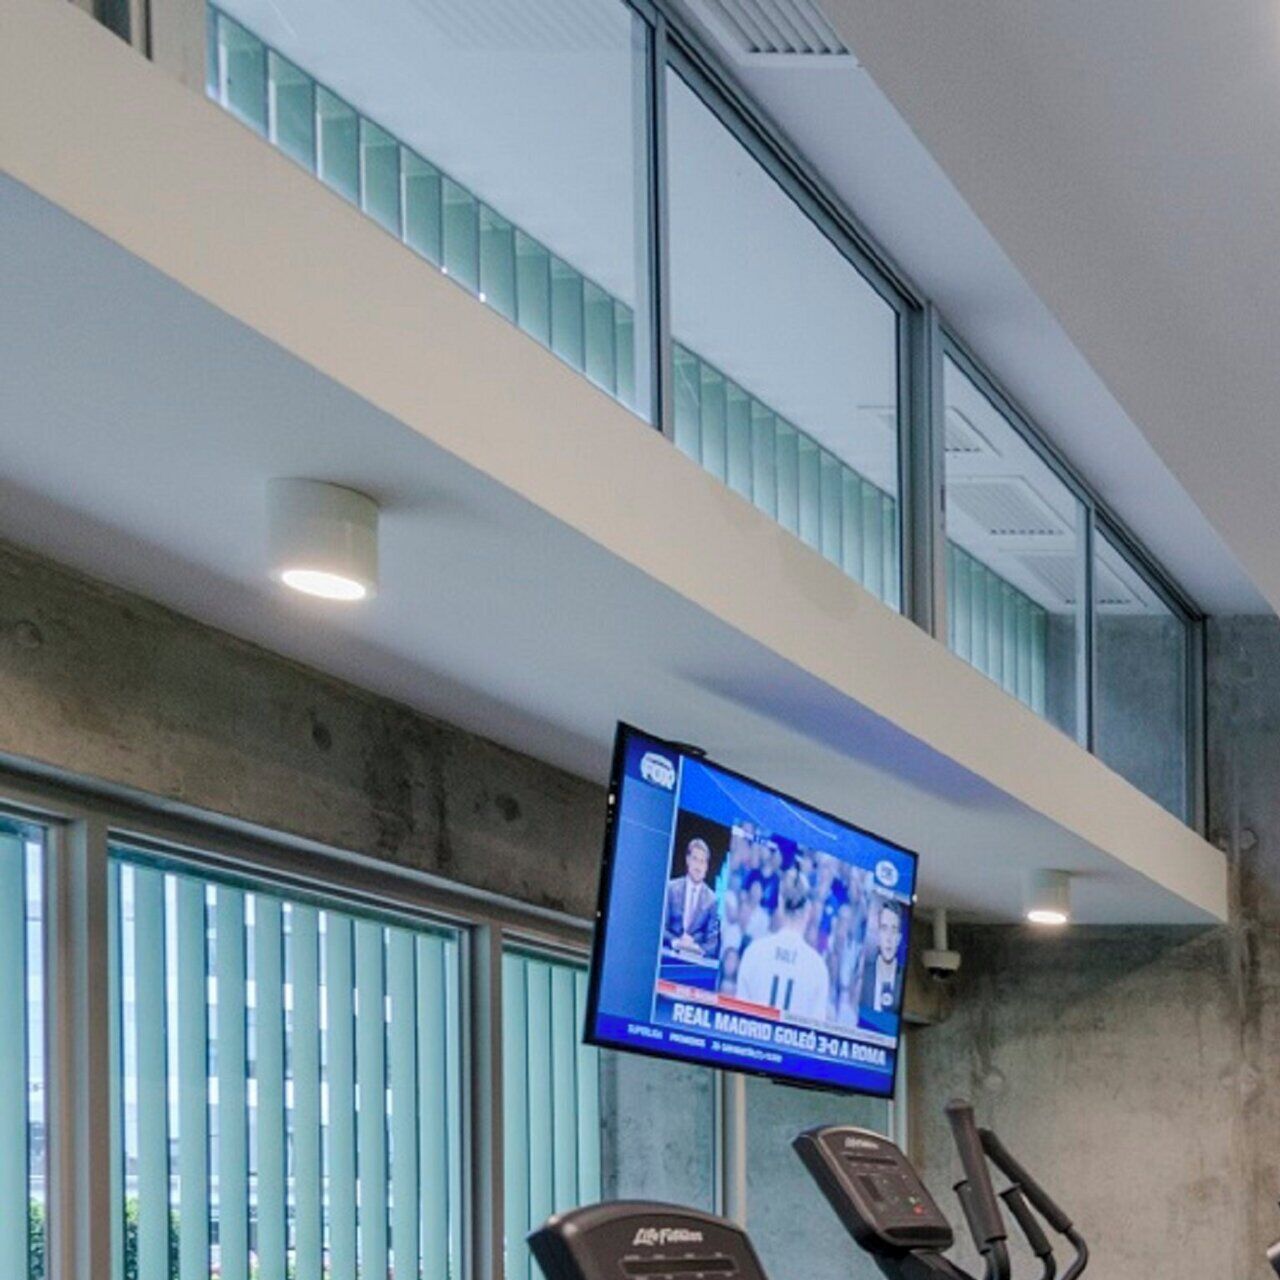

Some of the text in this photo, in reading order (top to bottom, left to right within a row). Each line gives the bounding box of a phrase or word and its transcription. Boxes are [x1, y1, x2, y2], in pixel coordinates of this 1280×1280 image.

[770, 974, 793, 1011] 11
[673, 1003, 711, 1027] REAL
[715, 1012, 771, 1040] MADRID
[774, 1026, 816, 1051] GOLEÓ
[817, 1036, 839, 1056] 3-0
[840, 1040, 849, 1058] A
[852, 1043, 886, 1066] ROMA
